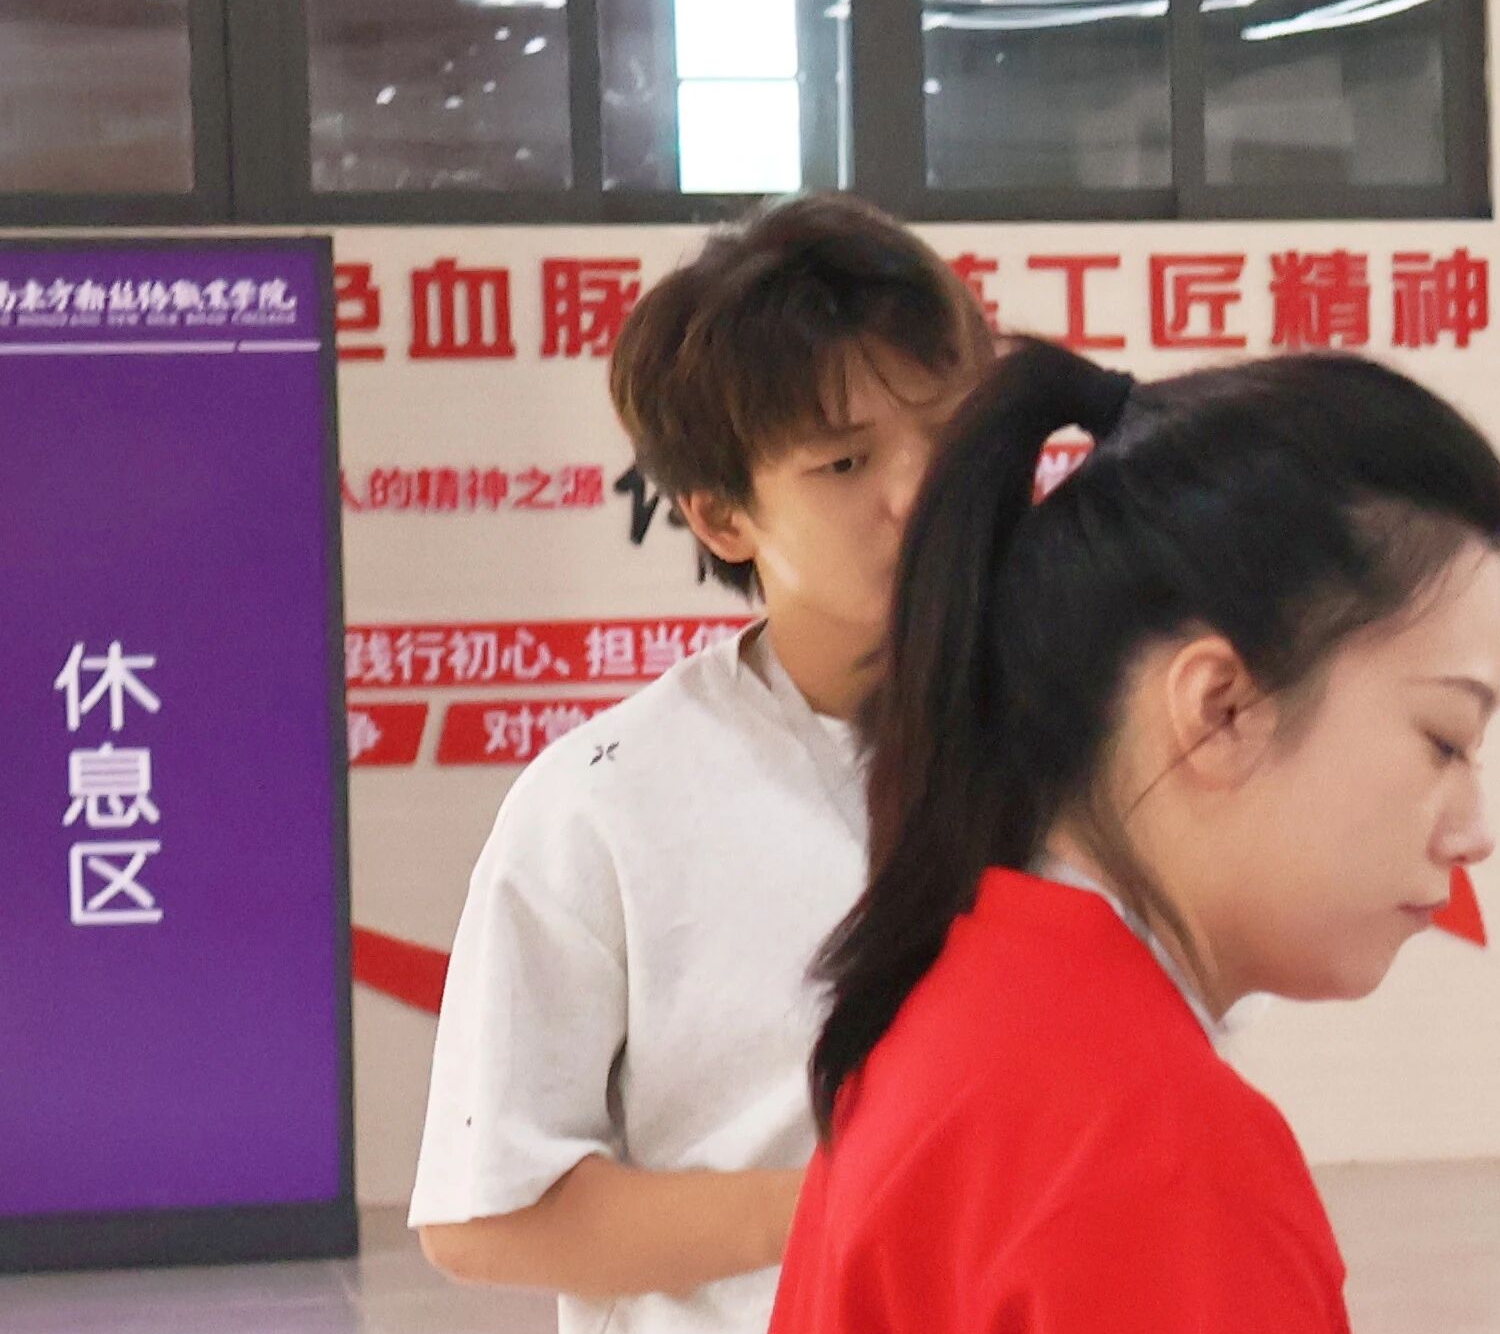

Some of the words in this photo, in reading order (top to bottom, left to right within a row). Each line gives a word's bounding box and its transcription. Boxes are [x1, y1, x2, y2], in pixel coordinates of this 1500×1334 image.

[945, 247, 1491, 350] 工匠精神
[53, 639, 165, 926] 休息区
